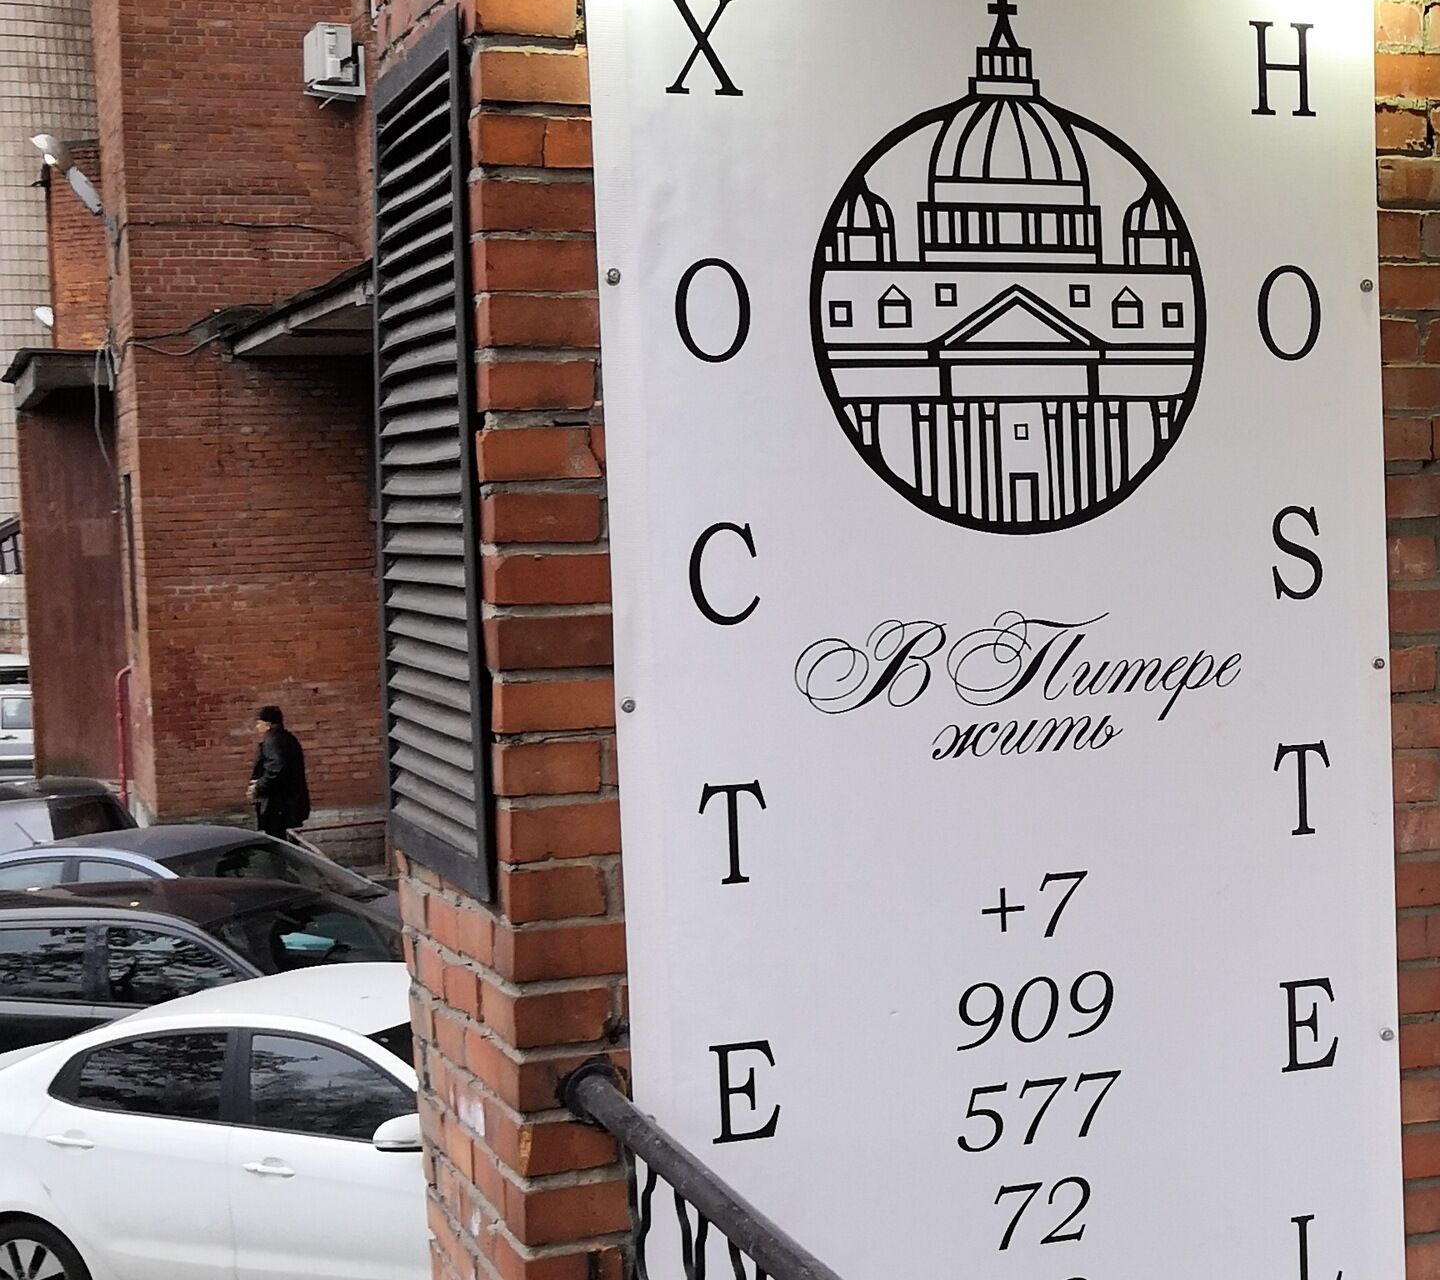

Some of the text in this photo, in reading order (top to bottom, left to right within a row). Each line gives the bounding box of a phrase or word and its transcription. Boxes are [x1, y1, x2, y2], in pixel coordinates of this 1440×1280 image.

[794, 610, 1242, 719] В Питере
[931, 714, 1123, 761] жить
[981, 870, 1088, 939] +7
[956, 970, 1114, 1052] 909
[956, 1069, 1121, 1153] 577
[993, 1176, 1091, 1252] 72
